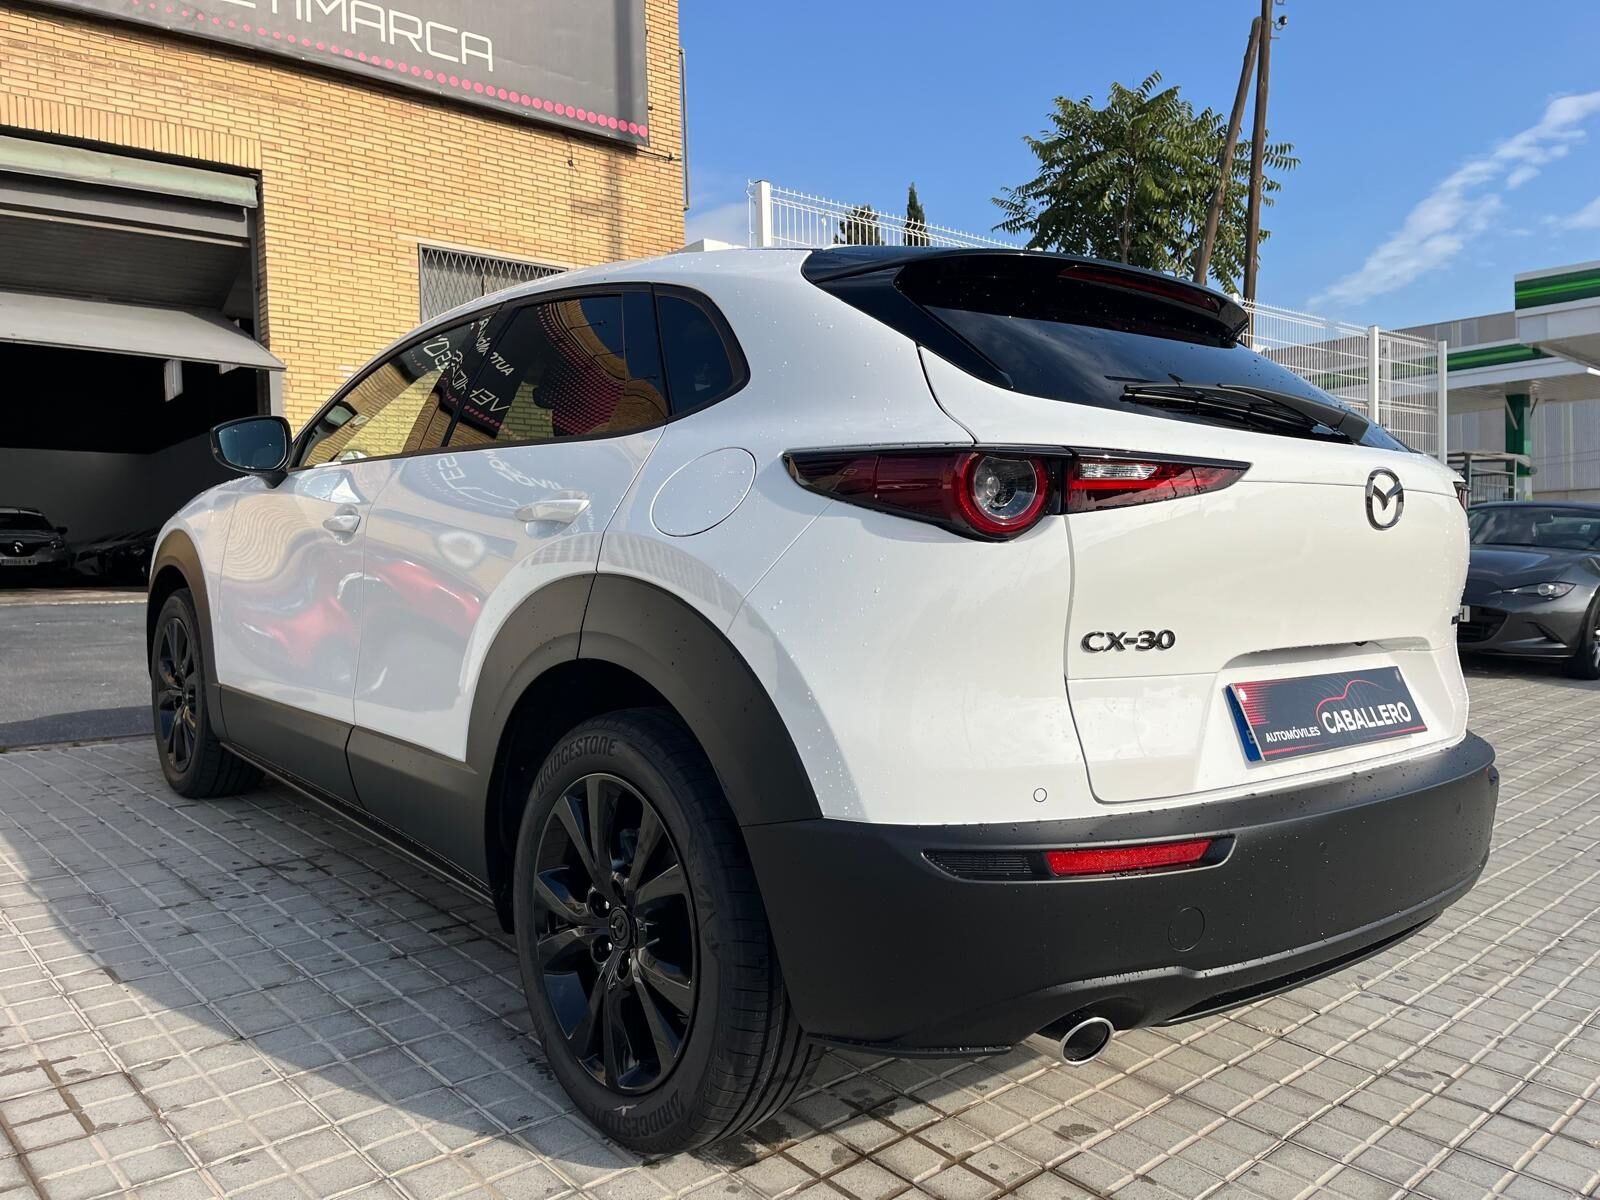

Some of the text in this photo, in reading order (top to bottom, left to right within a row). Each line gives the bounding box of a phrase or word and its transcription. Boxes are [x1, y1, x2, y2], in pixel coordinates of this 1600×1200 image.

[1080, 629, 1176, 653] CX-30
[1265, 701, 1412, 743] AUTOMÓVILES CABALLERO
